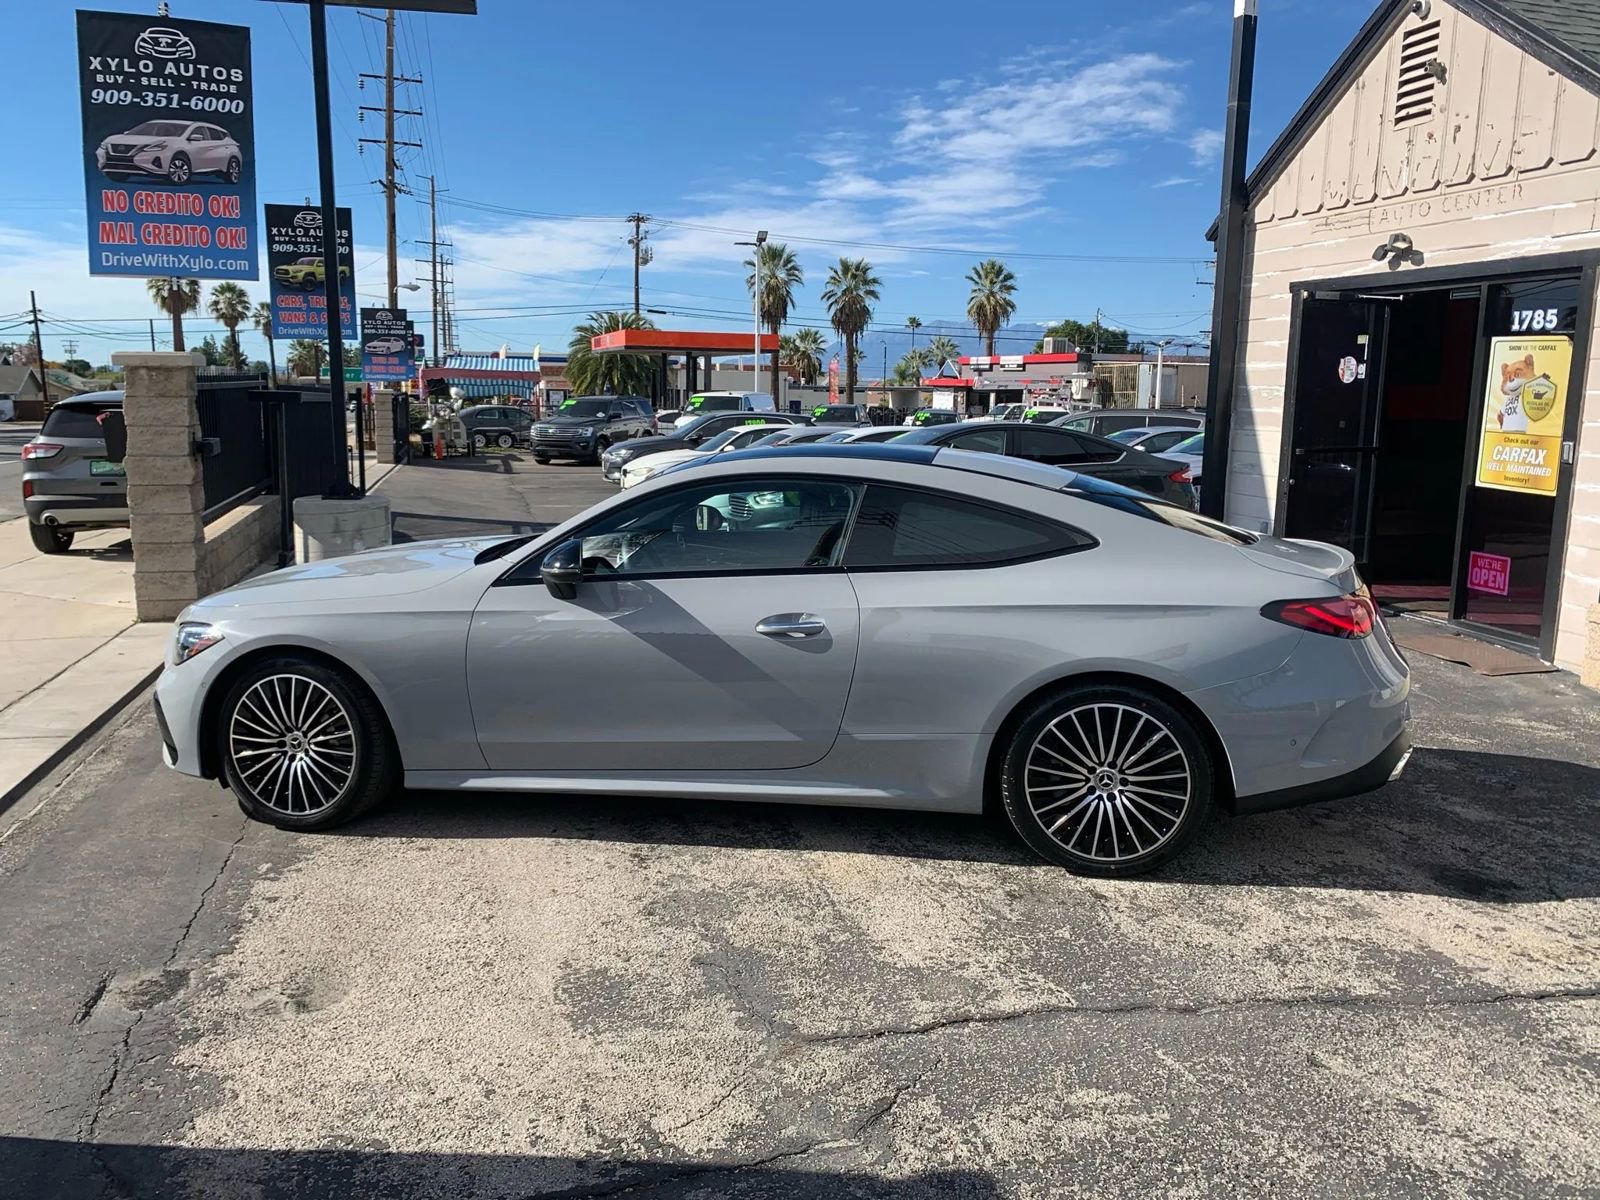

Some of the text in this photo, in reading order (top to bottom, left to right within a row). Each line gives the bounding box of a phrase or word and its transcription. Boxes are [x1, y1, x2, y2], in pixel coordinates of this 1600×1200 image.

[89, 56, 243, 82] XYLO AUTOS
[96, 74, 124, 84] BUY
[141, 77, 175, 87] SELL
[191, 81, 238, 93] TRADE
[91, 88, 244, 114] 909-351-6000
[102, 189, 241, 218] NO CREDITO OK!
[1441, 184, 1523, 213] CENTER
[99, 221, 247, 249] MAL CREDITO OK!
[271, 227, 349, 237] XYLO AUS
[272, 243, 349, 254] 909-351-00
[102, 252, 249, 272] DriveWithXylo.com
[276, 295, 351, 311] CARS, TRUS,
[279, 311, 351, 325] VANS & S'S
[1511, 308, 1558, 331] 1785
[278, 327, 353, 336] DriveWithXyom
[1504, 436, 1519, 444] Check
[1492, 445, 1548, 465] CARFAX
[1486, 461, 1552, 477] WELL MAINTAINED
[1503, 475, 1530, 485] Inventory!
[1477, 557, 1503, 571] WE'RE
[1471, 567, 1505, 590] OPEN
